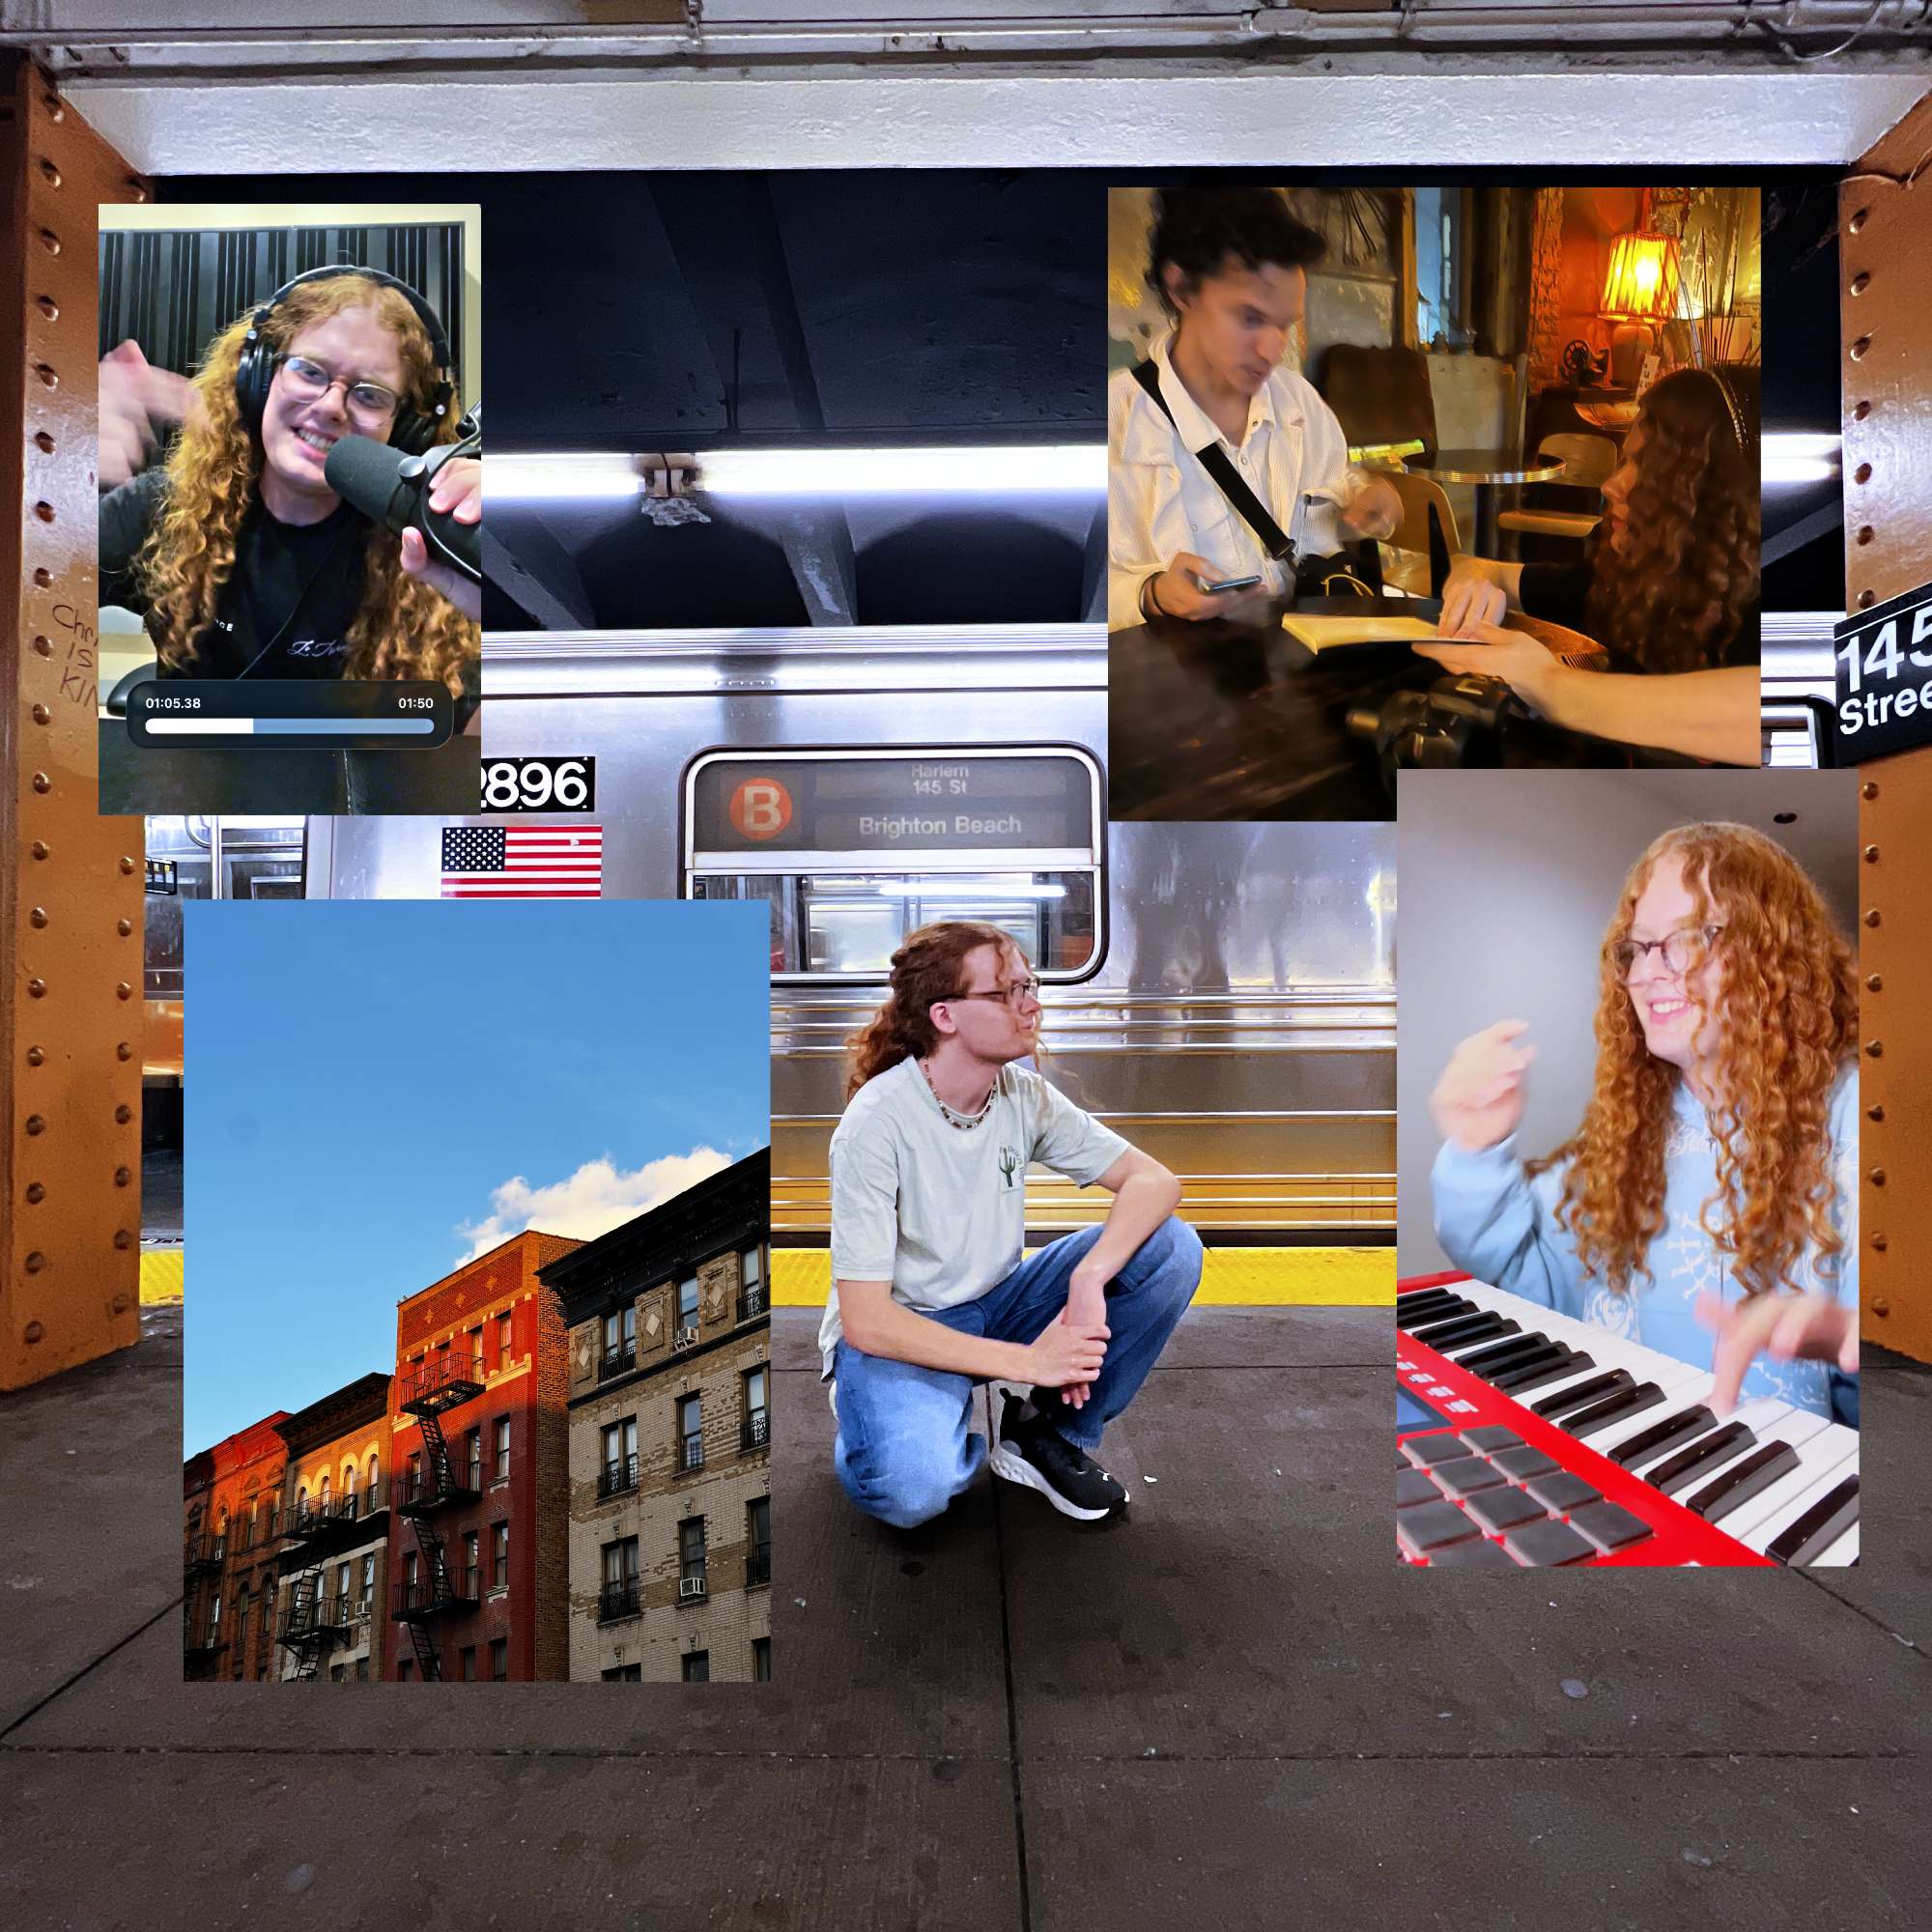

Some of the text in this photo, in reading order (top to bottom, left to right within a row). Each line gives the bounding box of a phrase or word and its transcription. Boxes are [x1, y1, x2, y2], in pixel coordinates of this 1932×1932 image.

[1838, 605, 1932, 693] 145
[481, 761, 587, 808] 896
[911, 763, 970, 778] Harlem
[913, 779, 967, 795] 145 St
[744, 785, 781, 832] B
[859, 815, 1022, 838] Brighton Beach
